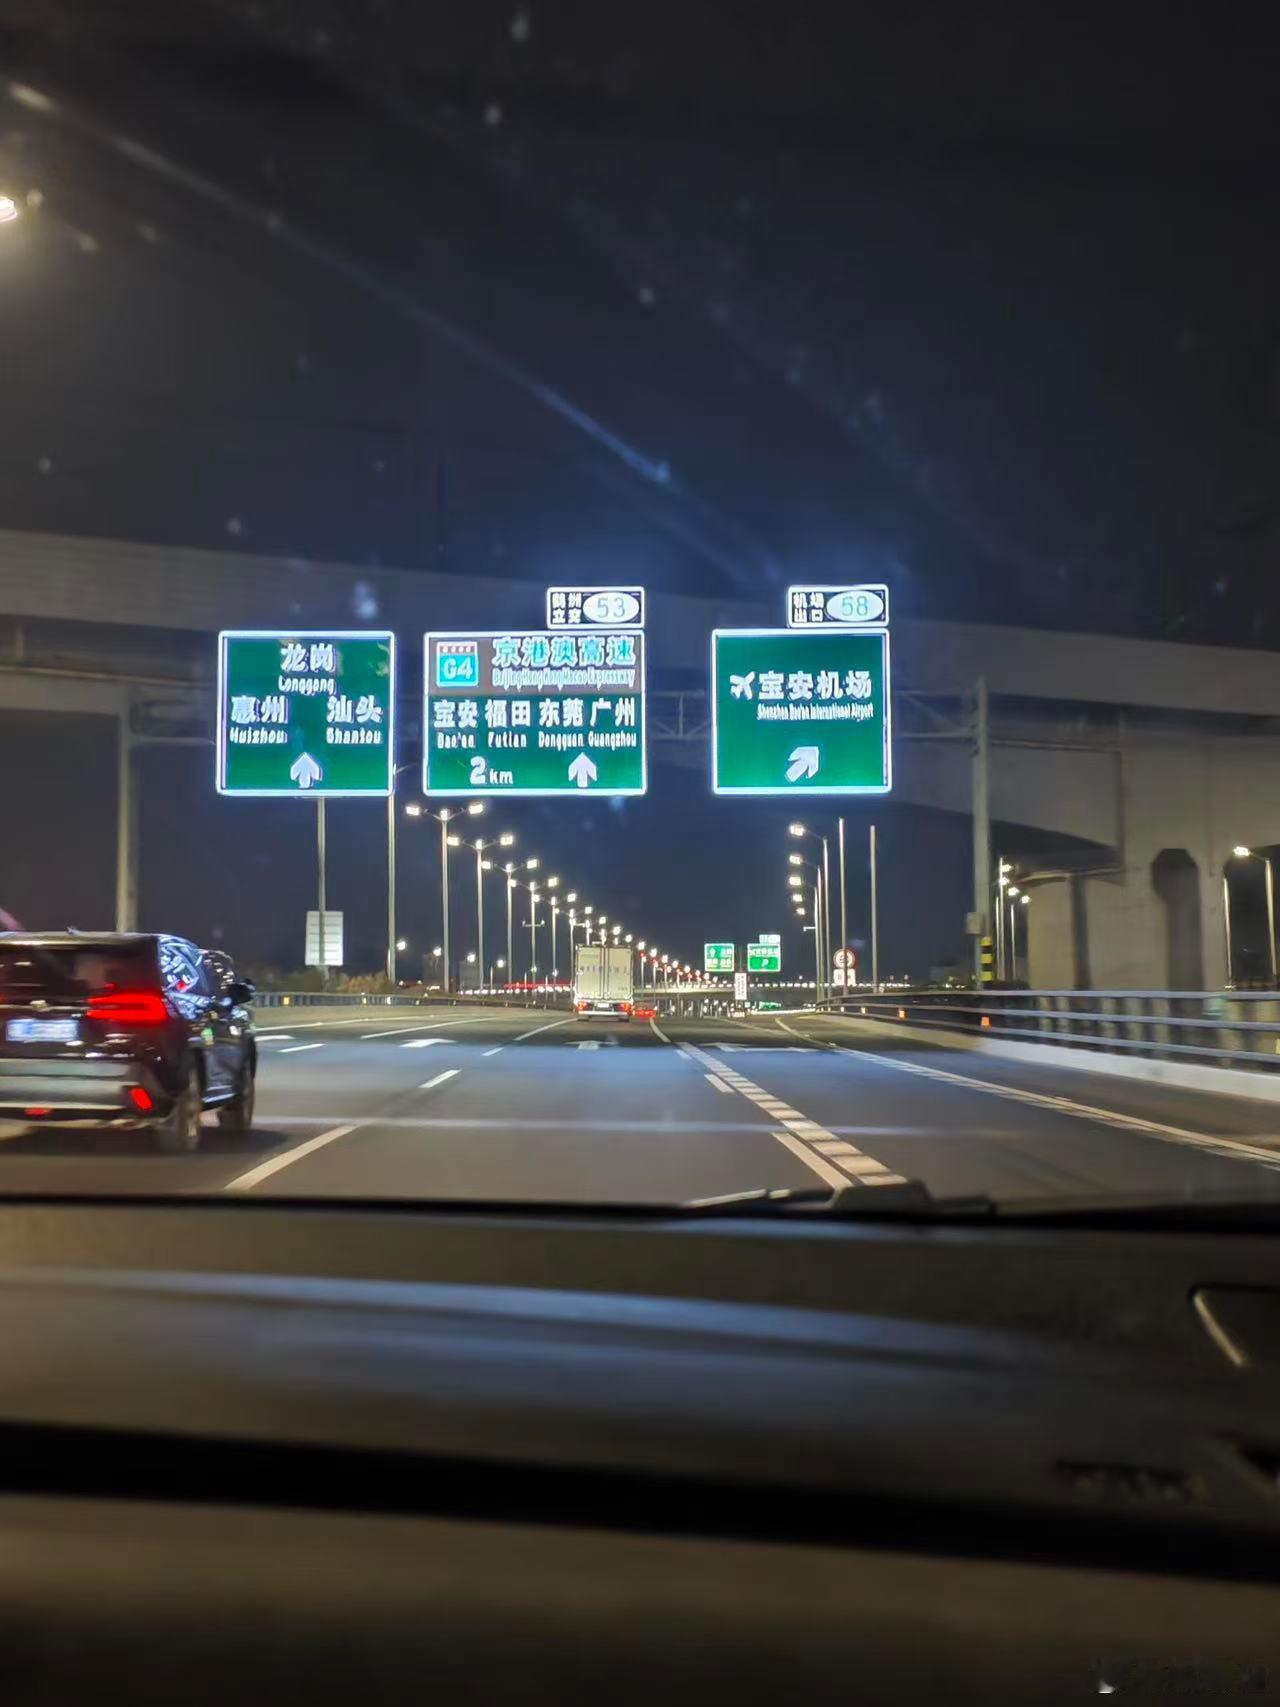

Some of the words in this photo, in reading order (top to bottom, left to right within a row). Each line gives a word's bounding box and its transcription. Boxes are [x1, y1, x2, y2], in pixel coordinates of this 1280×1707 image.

[597, 597, 626, 619] 53
[793, 592, 825, 609] 机场
[841, 595, 868, 617] 58
[552, 608, 582, 624] 立交
[793, 608, 824, 623] 出口
[280, 642, 336, 672] 龙岗
[491, 636, 636, 667] 京港澳高速
[443, 657, 473, 680] G4
[278, 675, 336, 695] Longgang
[758, 670, 872, 700] 宝安机场
[230, 695, 288, 723] 惠州
[326, 695, 383, 723] 汕头
[433, 700, 478, 728] 宝安
[485, 699, 531, 728] 福田
[539, 698, 584, 728] 东莞
[590, 698, 636, 727] 广州
[230, 727, 288, 744] Huizhou
[326, 727, 383, 745] Shantou
[588, 731, 637, 750] Guangzhou
[470, 755, 487, 785] 2
[489, 769, 514, 785] km
